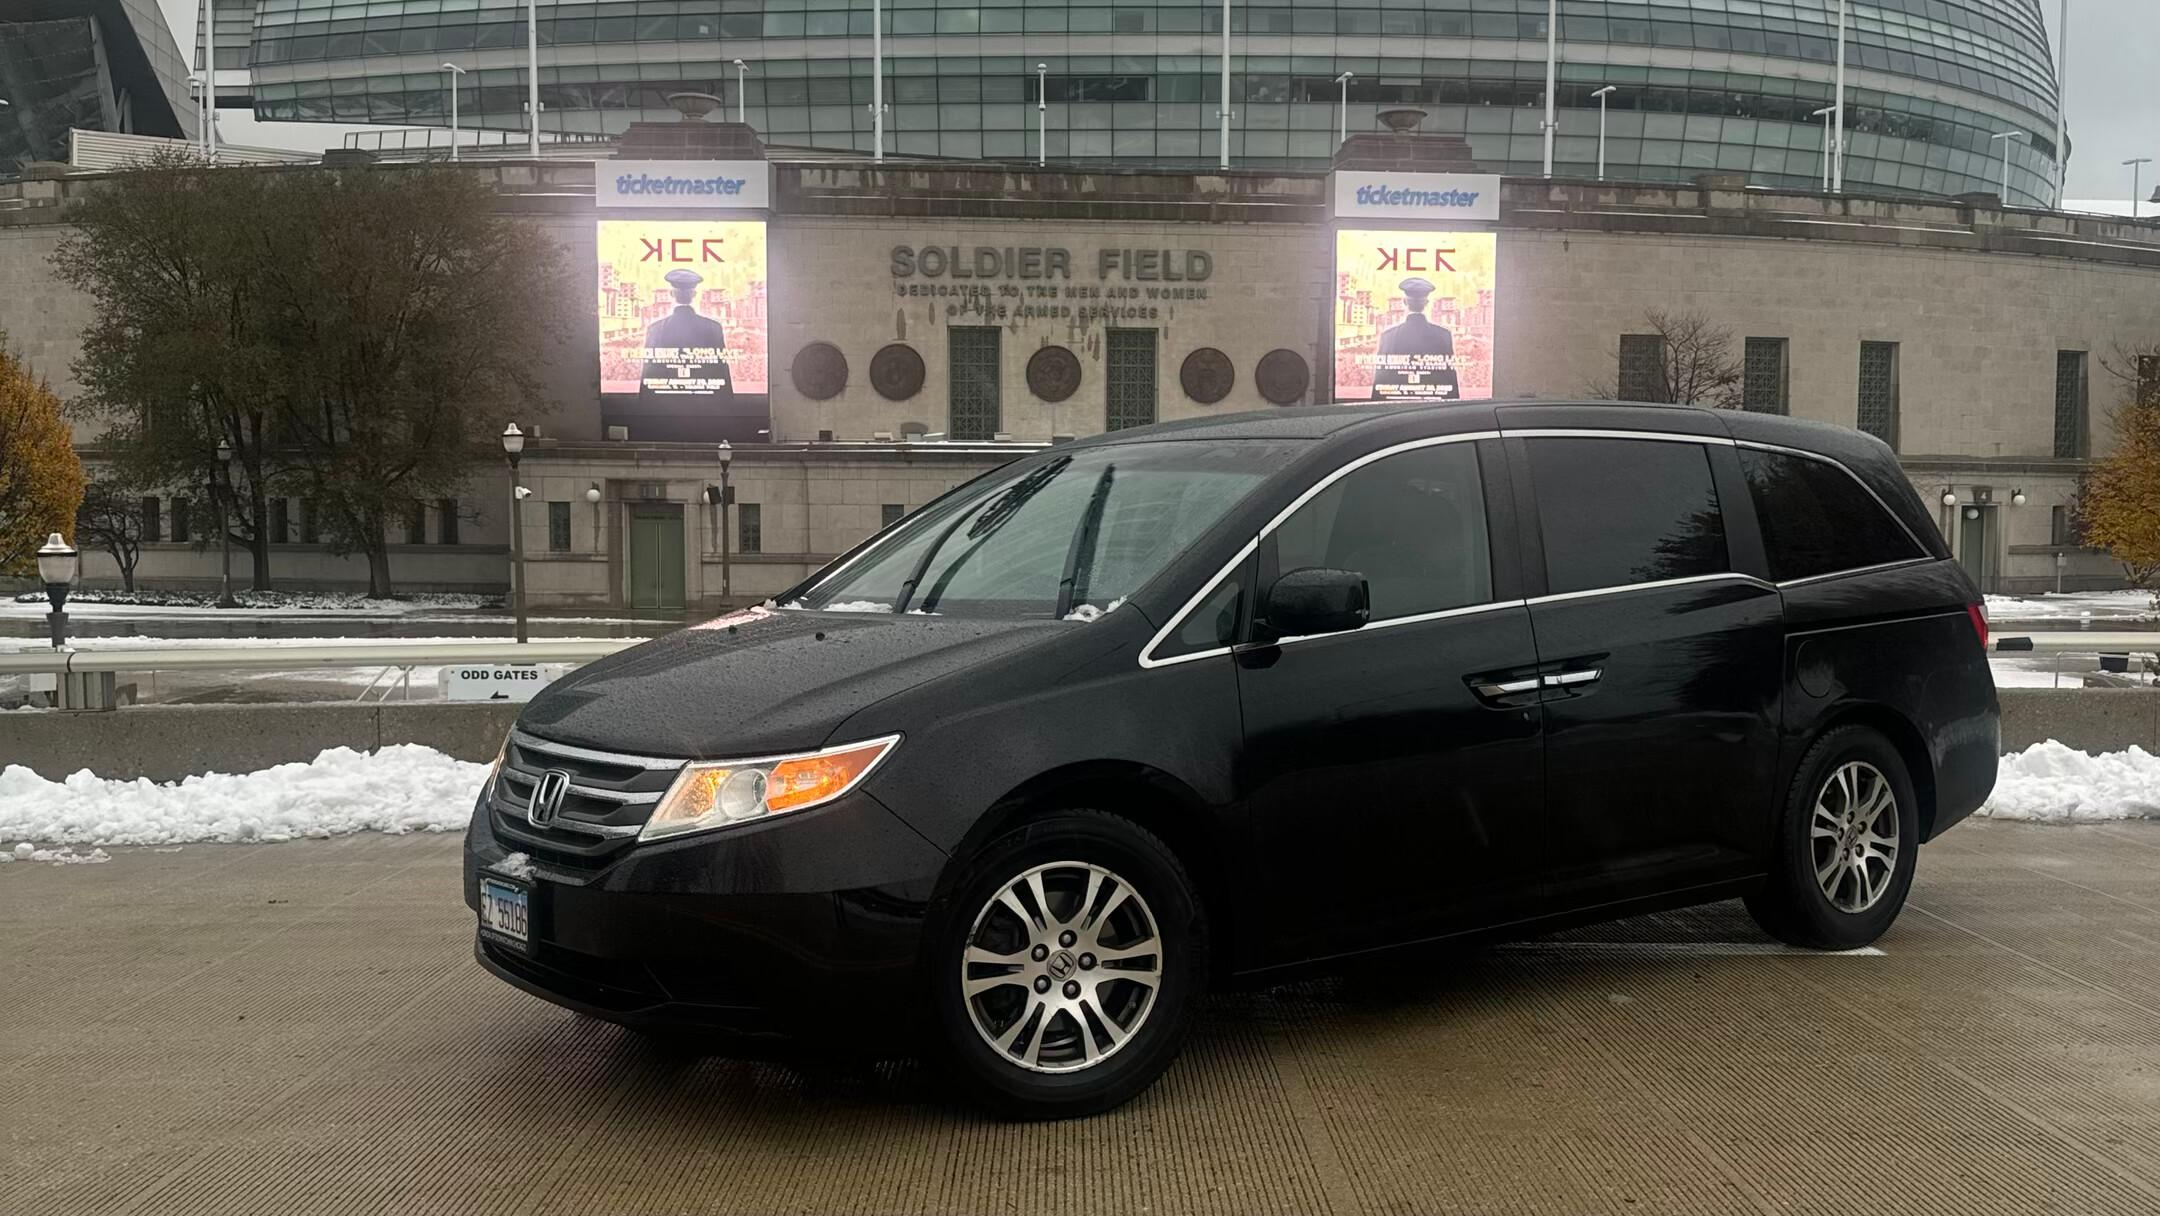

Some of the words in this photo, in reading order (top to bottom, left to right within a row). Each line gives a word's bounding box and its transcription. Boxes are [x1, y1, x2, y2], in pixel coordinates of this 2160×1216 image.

[616, 173, 746, 195] ticketmaster
[1356, 184, 1480, 208] ticketmaster
[890, 245, 1071, 280] SOLDIER
[1098, 248, 1213, 282] FIELD
[896, 284, 992, 298] DEDICATED
[998, 284, 1020, 298] TO
[1026, 285, 1058, 299] THE
[1064, 286, 1100, 299] MEN
[1106, 286, 1140, 299] AND
[1146, 287, 1208, 300] WOMEN
[946, 304, 968, 317] OF
[1013, 305, 1071, 318] ARMED
[1078, 306, 1158, 319] SERVICES
[460, 670, 490, 680] ODD
[493, 670, 538, 680] GATES
[497, 896, 528, 937] 55186
